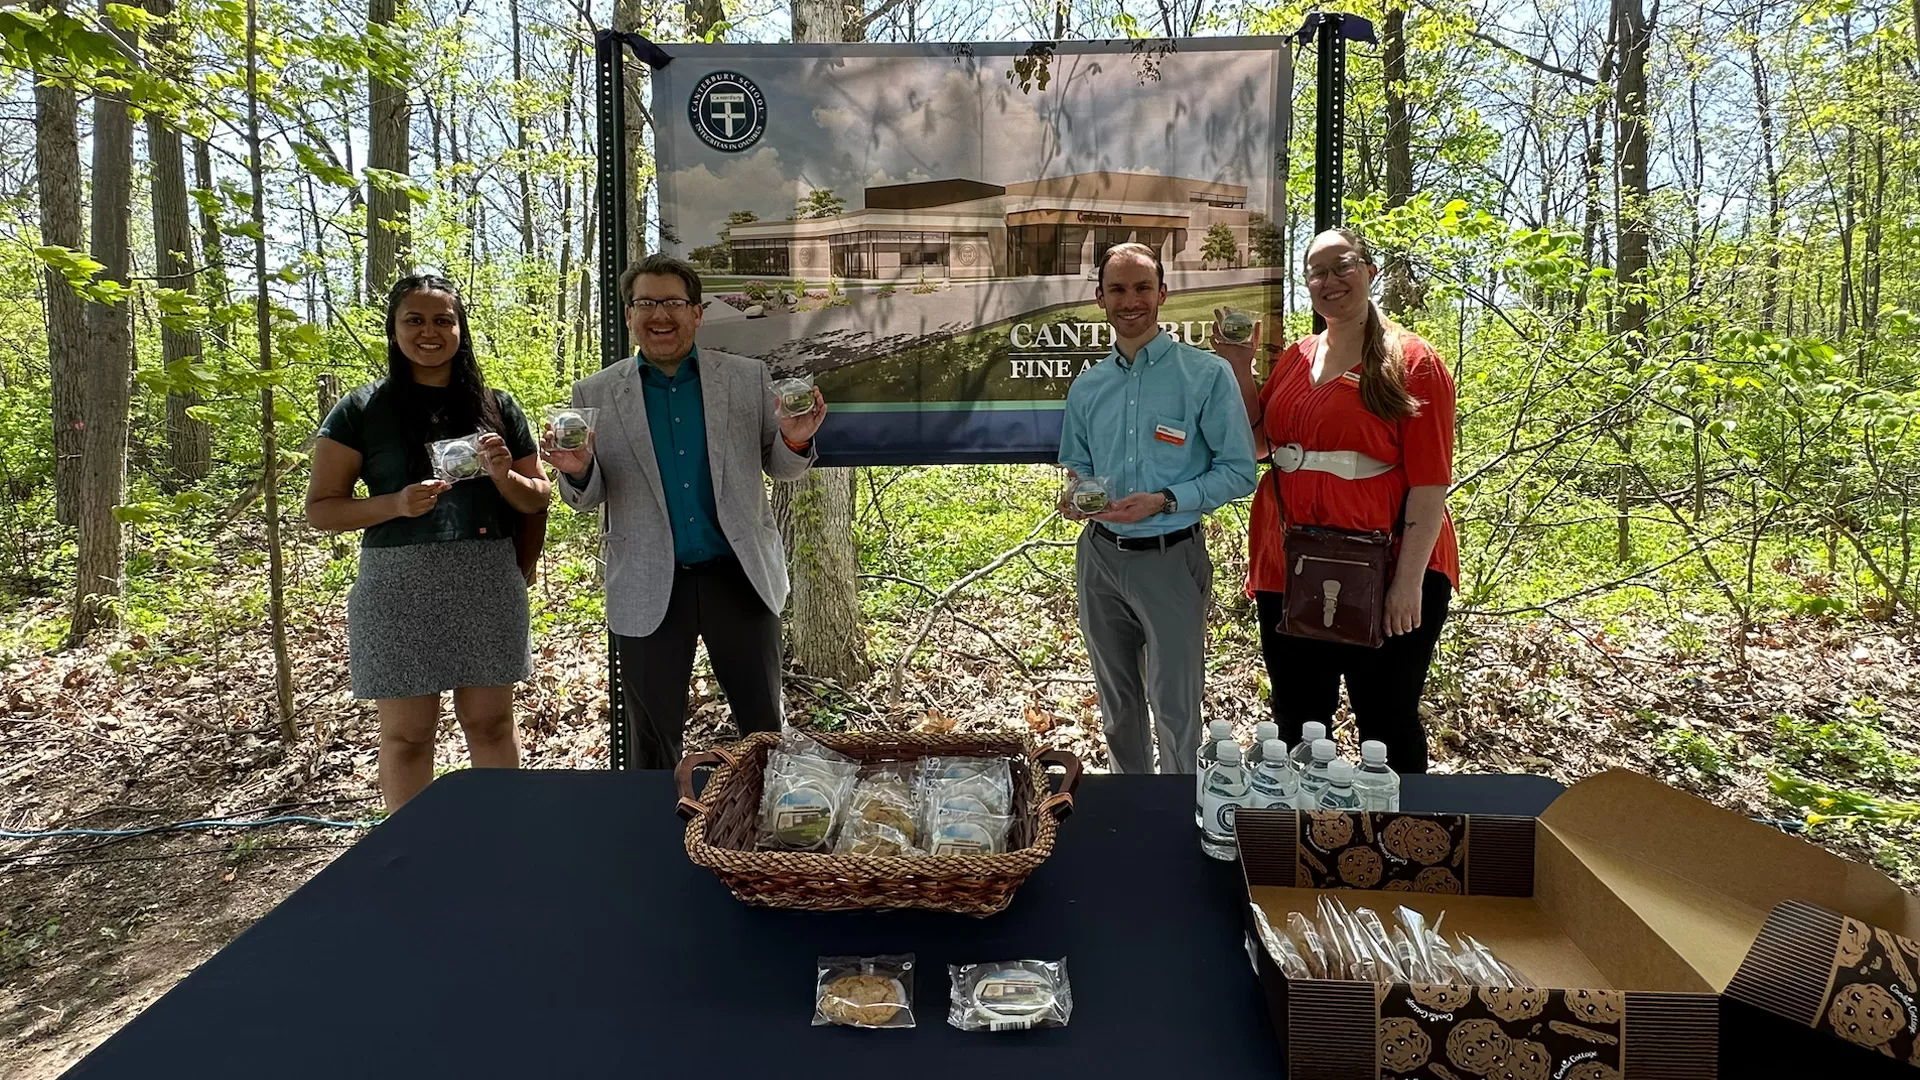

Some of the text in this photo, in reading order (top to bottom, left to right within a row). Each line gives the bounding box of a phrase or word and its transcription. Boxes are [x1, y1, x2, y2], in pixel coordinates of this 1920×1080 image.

[691, 73, 765, 112] CANTERBURY SCHOOL
[694, 123, 729, 150] INTEGRITAS
[737, 125, 763, 149] OMNIBUS
[1010, 360, 1072, 379] FINE
[1405, 997, 1454, 1022] Cookie Cottage
[1889, 983, 1919, 1035] Cookie Cottage
[1553, 1051, 1598, 1080] Cookie Cottage
